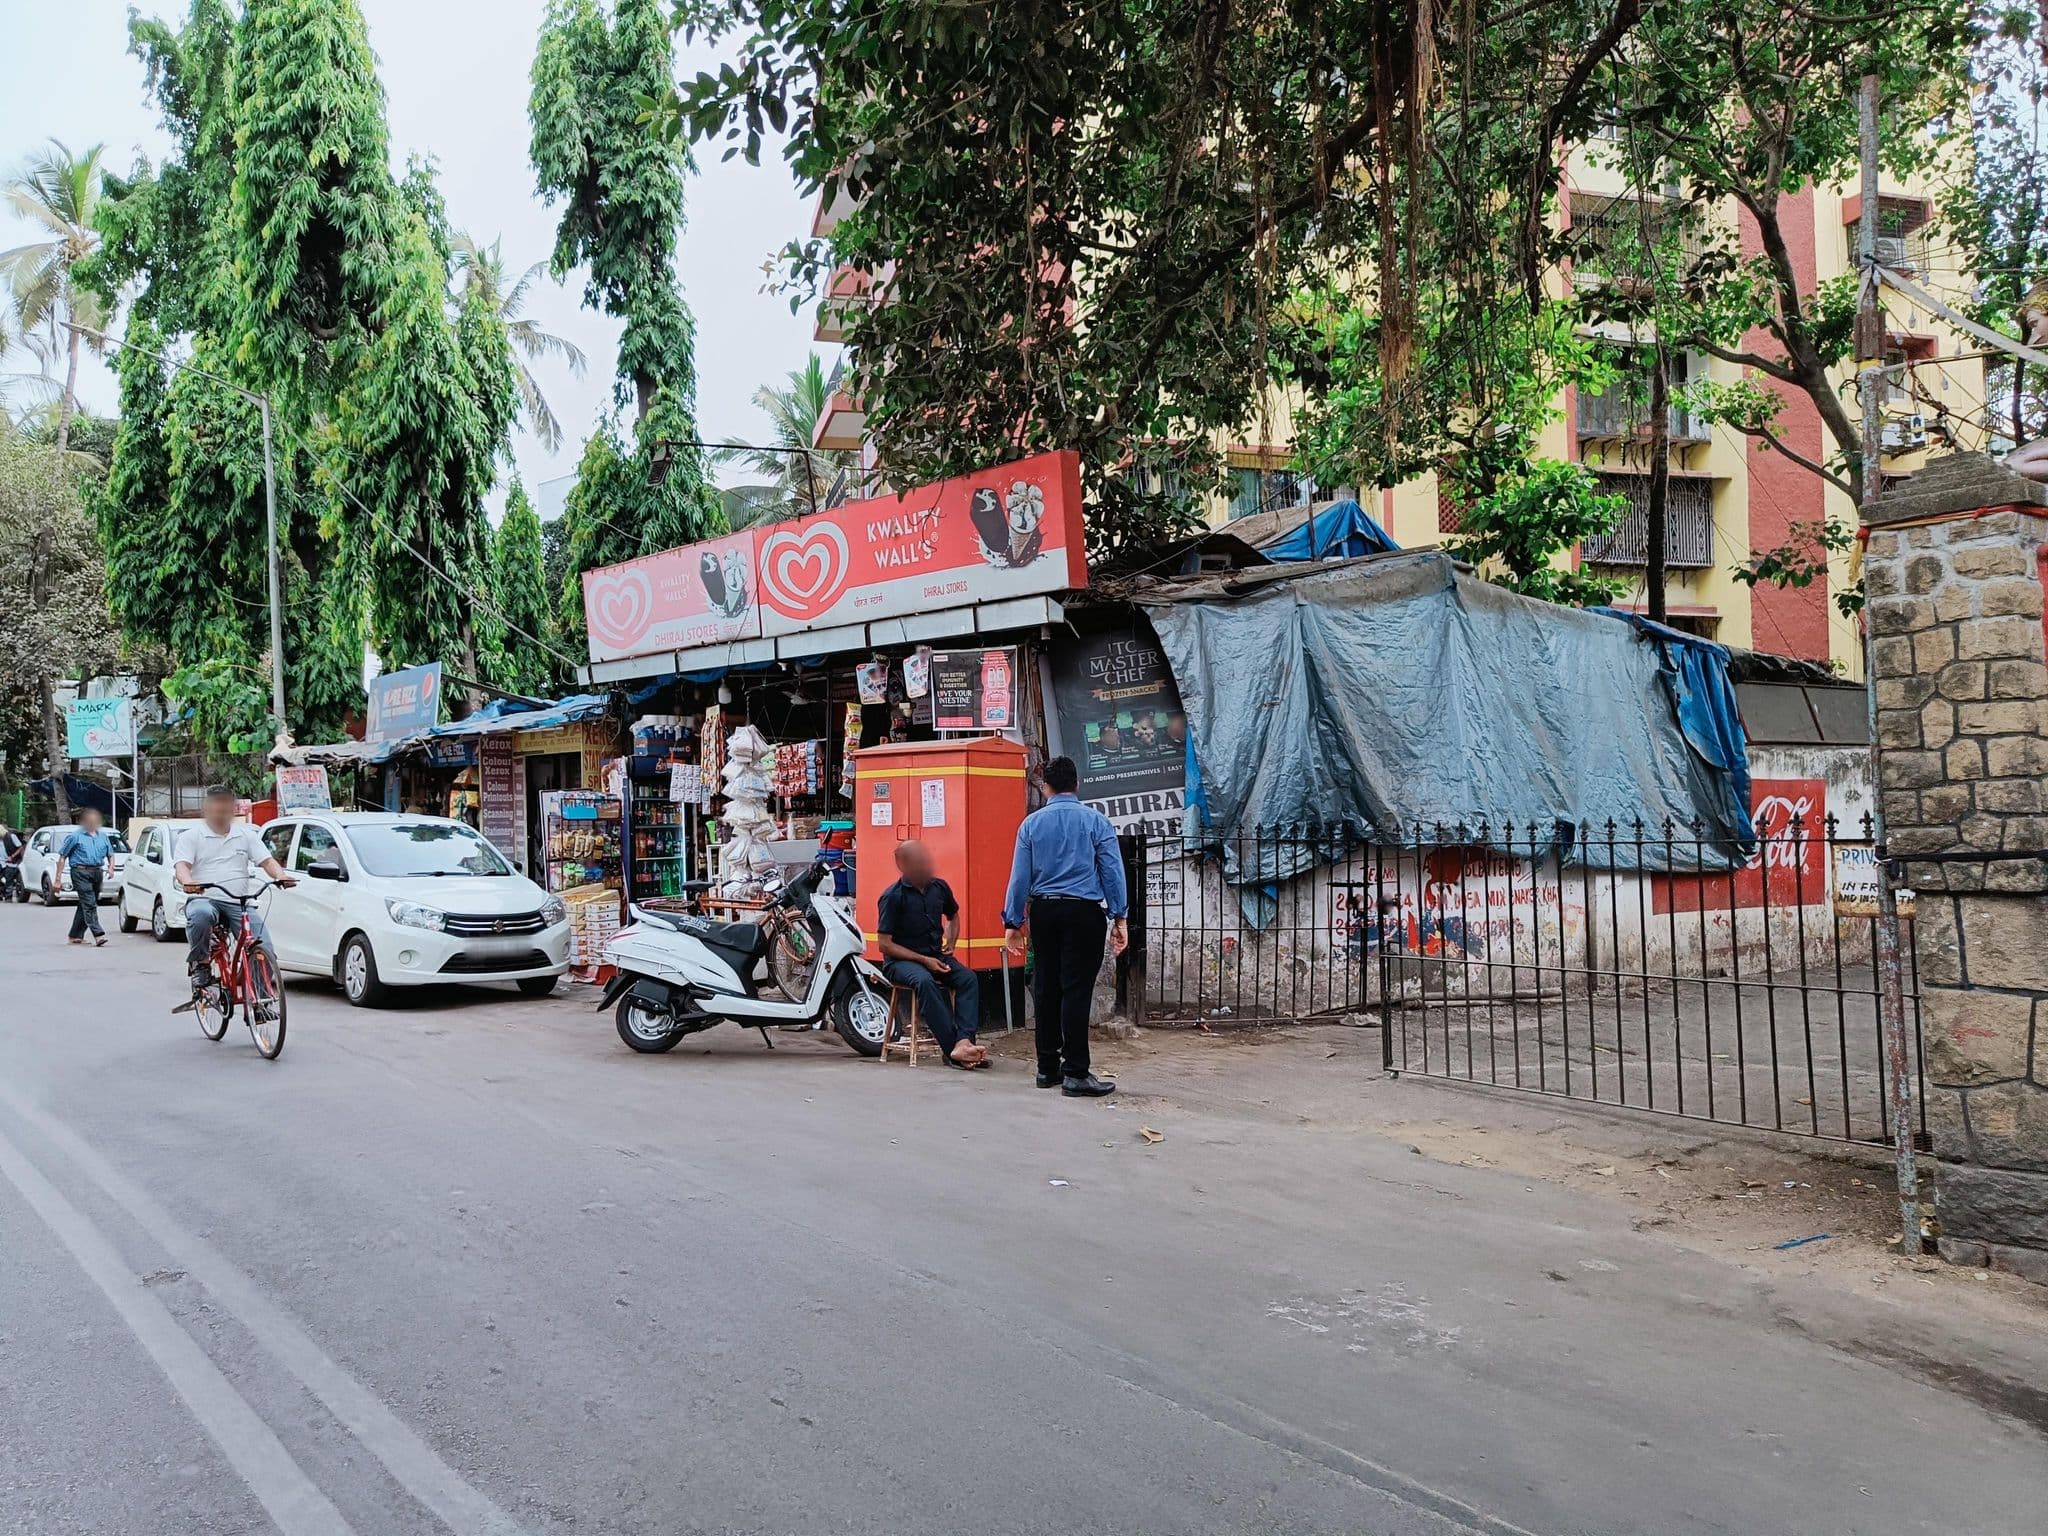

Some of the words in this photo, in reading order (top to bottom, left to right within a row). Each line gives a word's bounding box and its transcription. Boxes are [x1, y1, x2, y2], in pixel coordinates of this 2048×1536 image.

[867, 507, 941, 542] KWALITY
[923, 587, 945, 598] DHIRAJ
[946, 580, 968, 594] STORES
[654, 630, 685, 647] DHIRAJ
[687, 623, 719, 640] STORES
[1107, 640, 1138, 654] ITC
[1089, 650, 1160, 674] MASTER
[1104, 666, 1147, 685] CHEF
[954, 689, 972, 697] YOUR
[1129, 685, 1157, 697] SNACKS
[938, 696, 971, 704] INTESTINE
[77, 702, 113, 713] MARK
[482, 738, 512, 751] Xerox
[482, 756, 512, 767] Colour
[484, 766, 510, 776] Xerox
[1095, 774, 1115, 783] ADDED
[1116, 767, 1161, 779] PRESERVATIVES
[1167, 764, 1184, 772] EASY
[487, 781, 509, 792] Colour
[1084, 789, 1184, 818] DHIRA
[1841, 848, 1875, 865] PRIV
[1842, 882, 1857, 891] IN
[1861, 882, 1879, 892] FR
